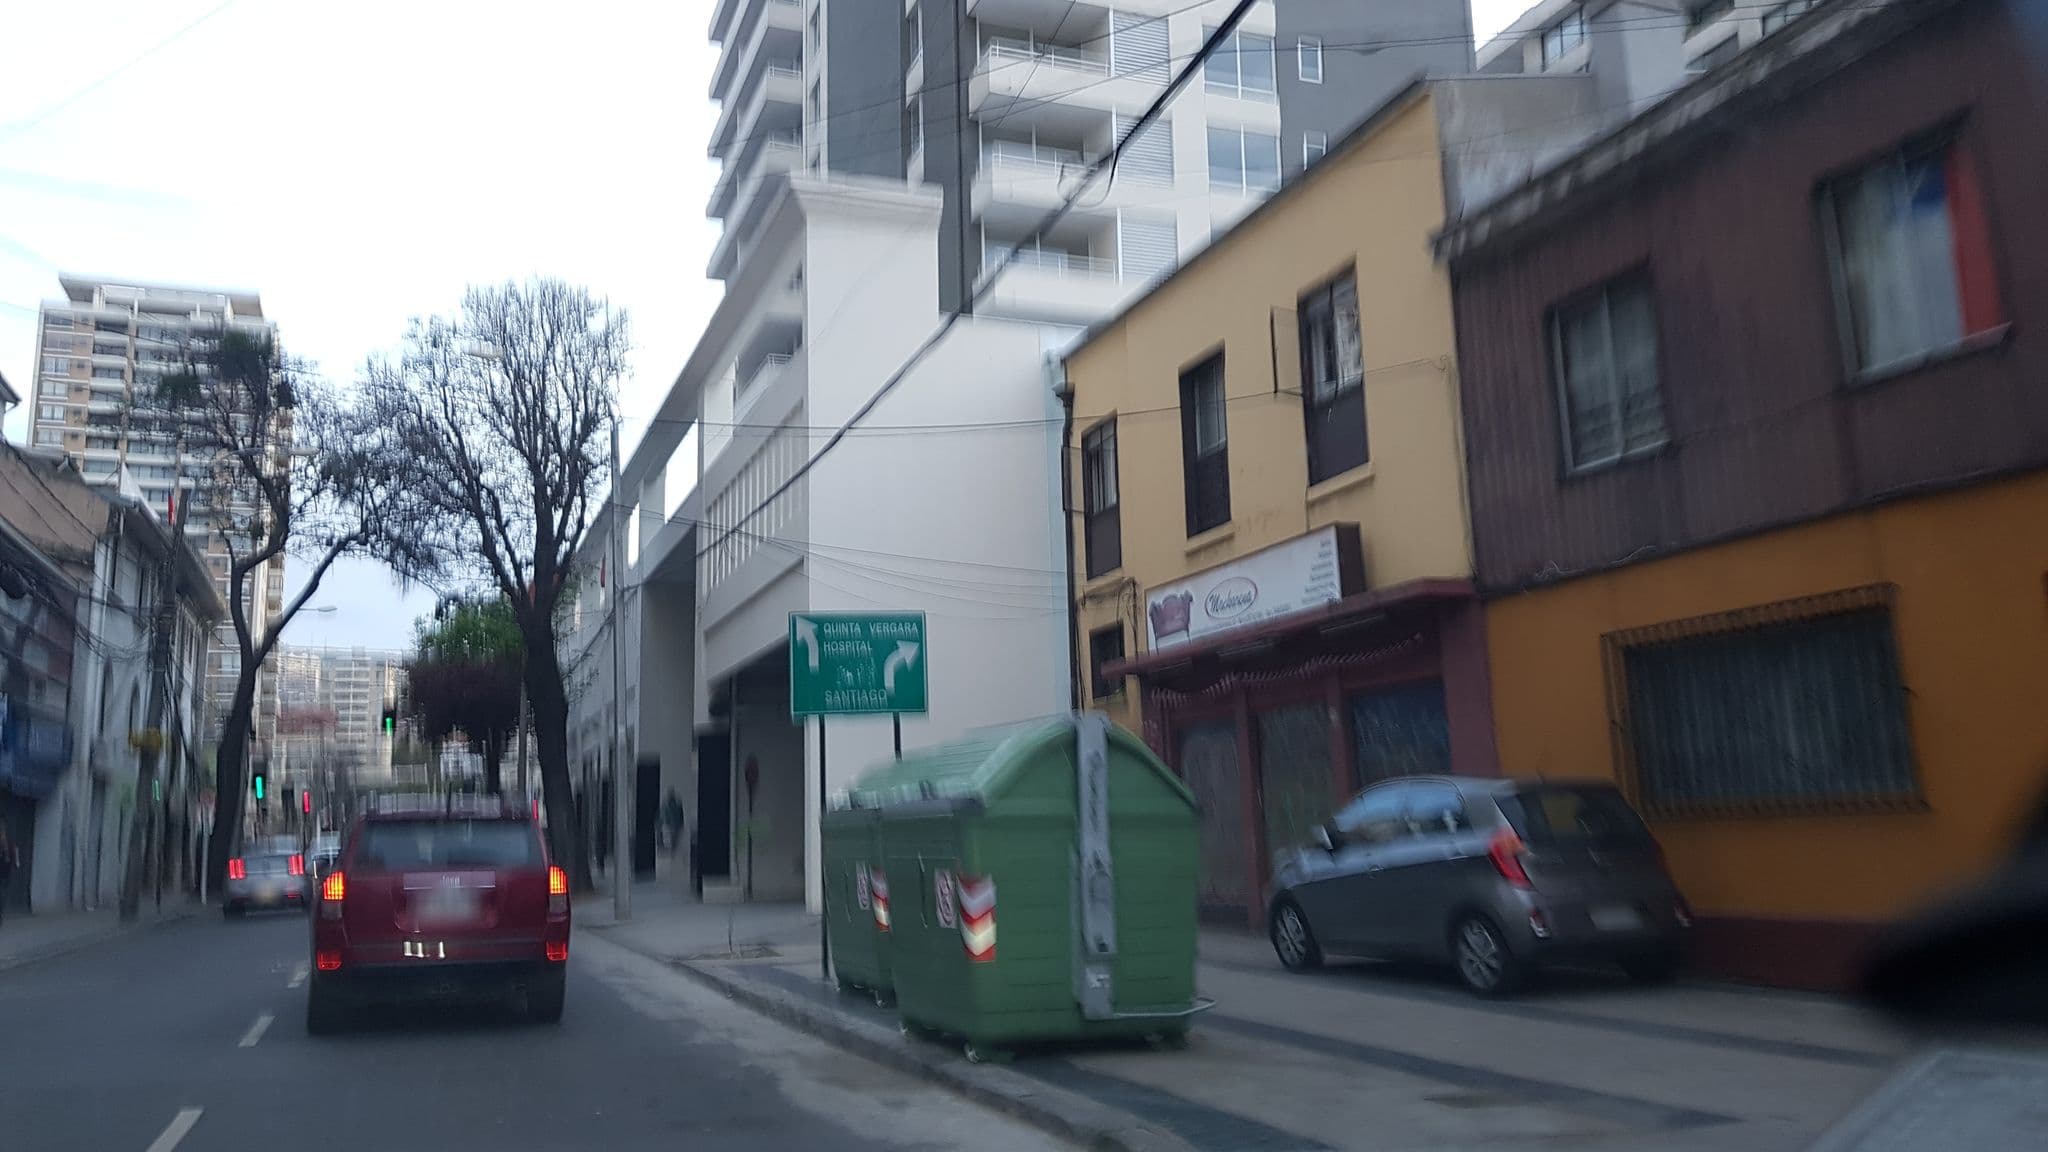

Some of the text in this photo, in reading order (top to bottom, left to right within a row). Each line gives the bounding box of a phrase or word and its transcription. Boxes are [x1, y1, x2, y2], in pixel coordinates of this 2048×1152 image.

[823, 622, 919, 635] QUINTA VERGARA
[823, 640, 873, 654] HOSPITAL
[824, 689, 888, 704] SANTIAGO
